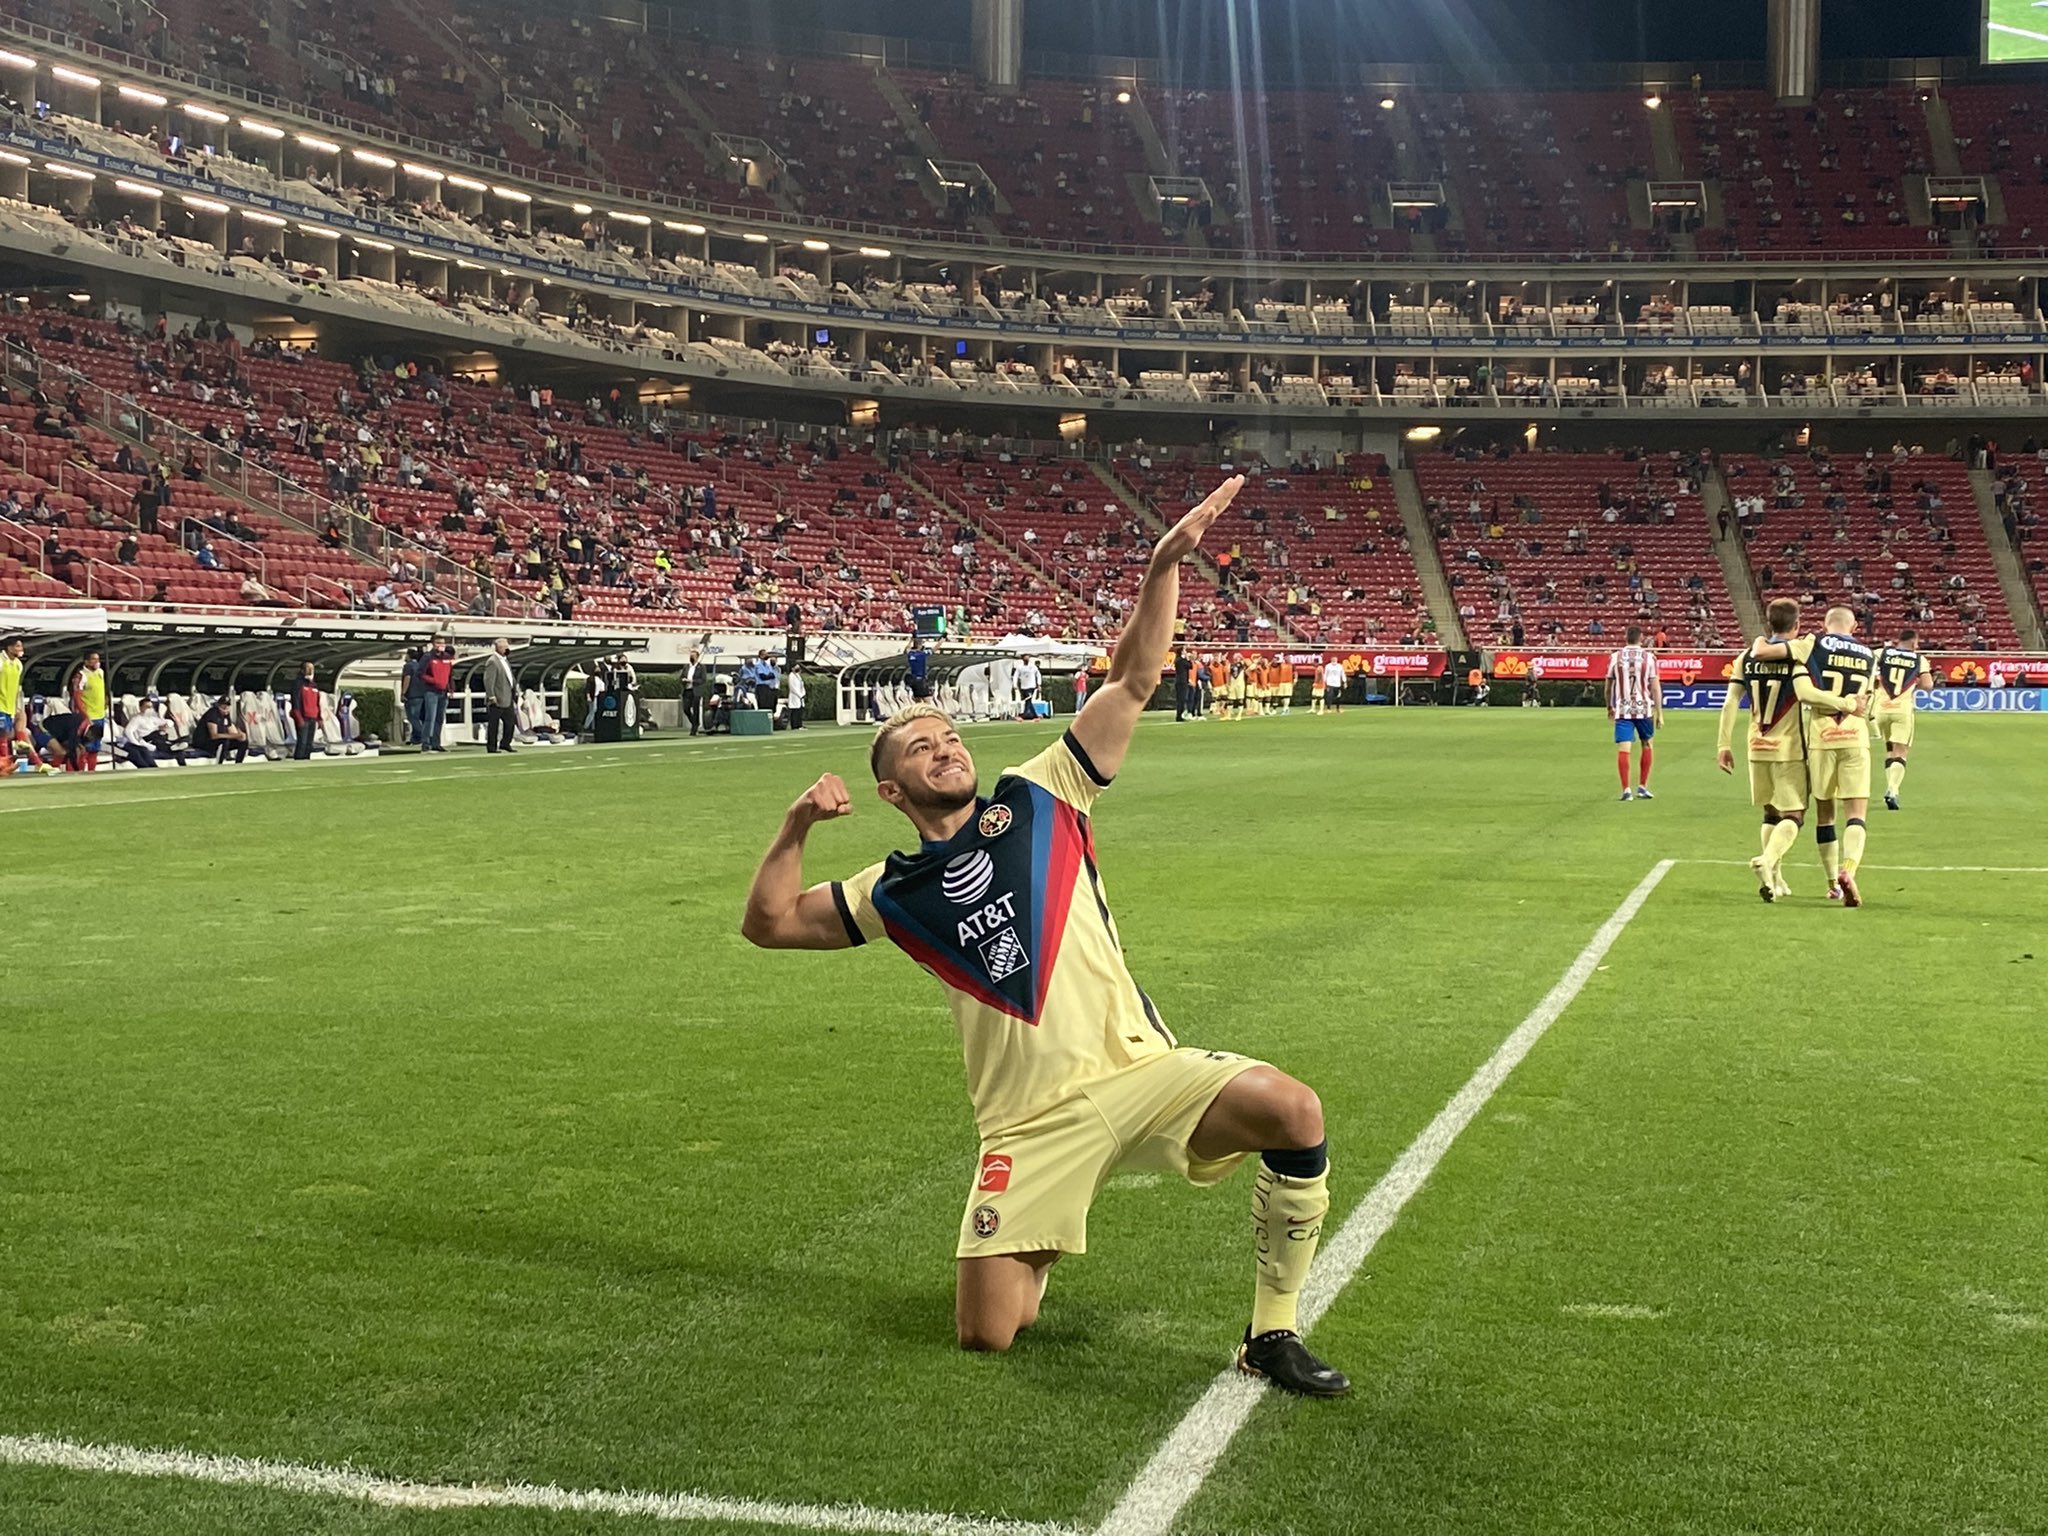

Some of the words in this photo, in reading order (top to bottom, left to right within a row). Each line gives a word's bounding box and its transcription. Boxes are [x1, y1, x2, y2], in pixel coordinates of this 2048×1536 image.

[1373, 654, 1428, 674] granvita
[1532, 656, 1589, 675] granvita
[1655, 657, 1703, 669] ranvita
[1889, 667, 1906, 696] 4
[1663, 690, 1729, 705] PS5
[1750, 679, 1782, 725] 17
[956, 891, 1016, 947] AT&T
[991, 930, 1015, 978] HOME
[1004, 942, 1020, 972] DEPOT
